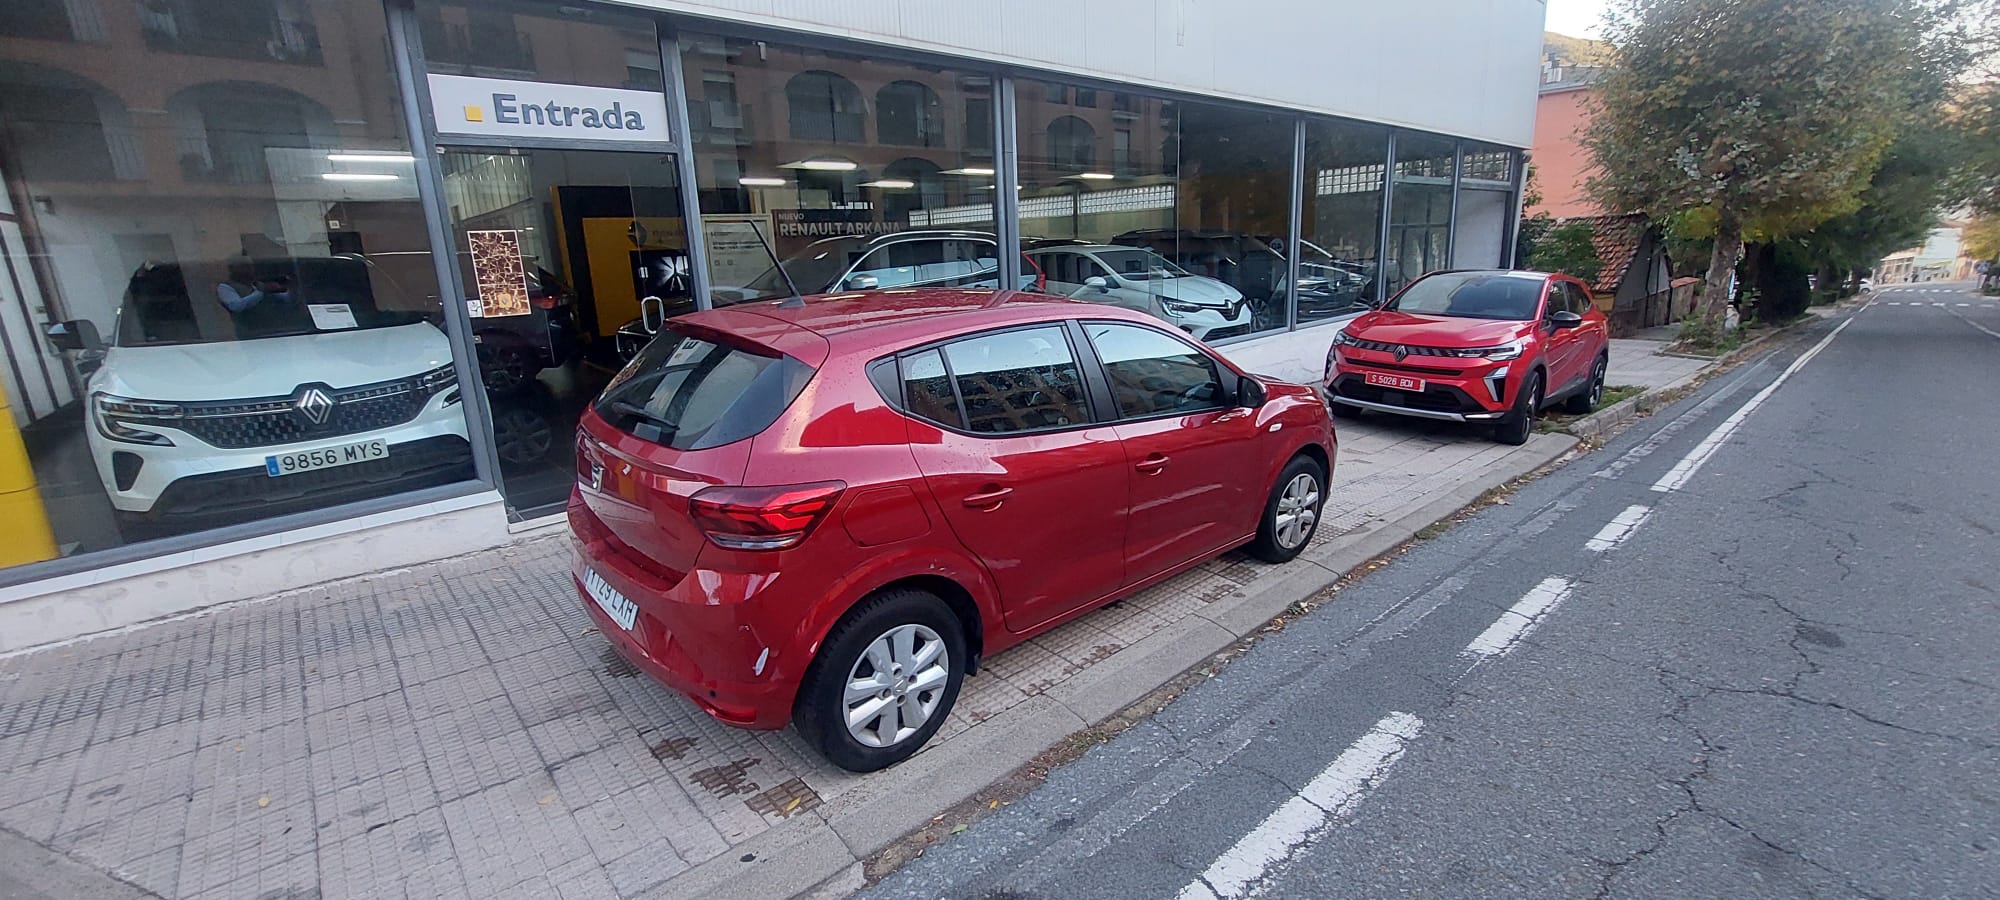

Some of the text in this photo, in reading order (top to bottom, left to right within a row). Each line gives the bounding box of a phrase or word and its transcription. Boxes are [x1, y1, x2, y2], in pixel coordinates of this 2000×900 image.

[492, 92, 645, 131] Entrada
[778, 212, 805, 221] NUEVO
[779, 221, 900, 237] RENAULT ARKANA
[1371, 374, 1377, 383] S
[282, 441, 382, 471] 9856 MYS
